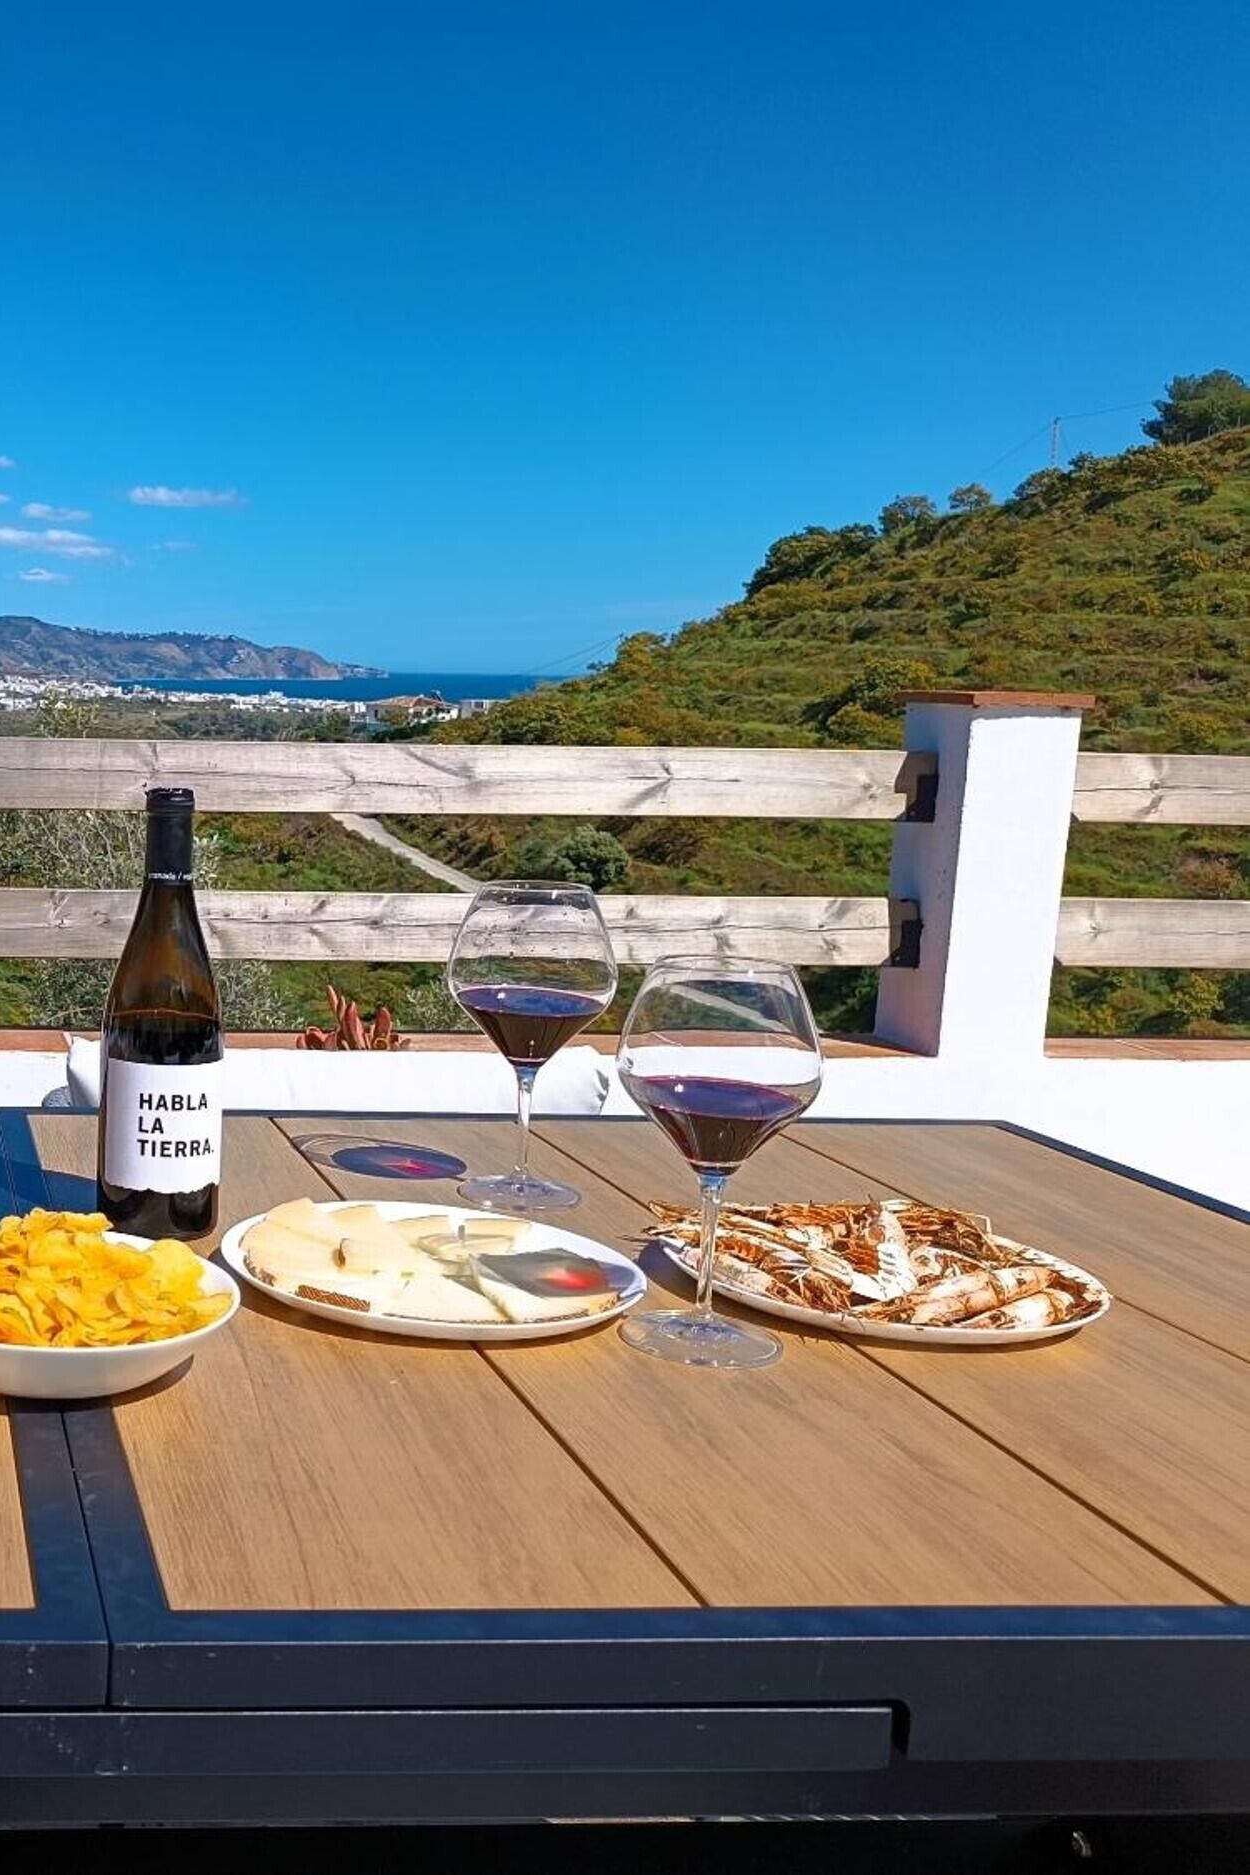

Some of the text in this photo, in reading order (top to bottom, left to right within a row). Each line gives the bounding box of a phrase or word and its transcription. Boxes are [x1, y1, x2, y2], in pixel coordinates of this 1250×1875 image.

[138, 1092, 209, 1111] HABLA
[137, 1116, 164, 1134] LA
[136, 1138, 214, 1158] TIERRA.
